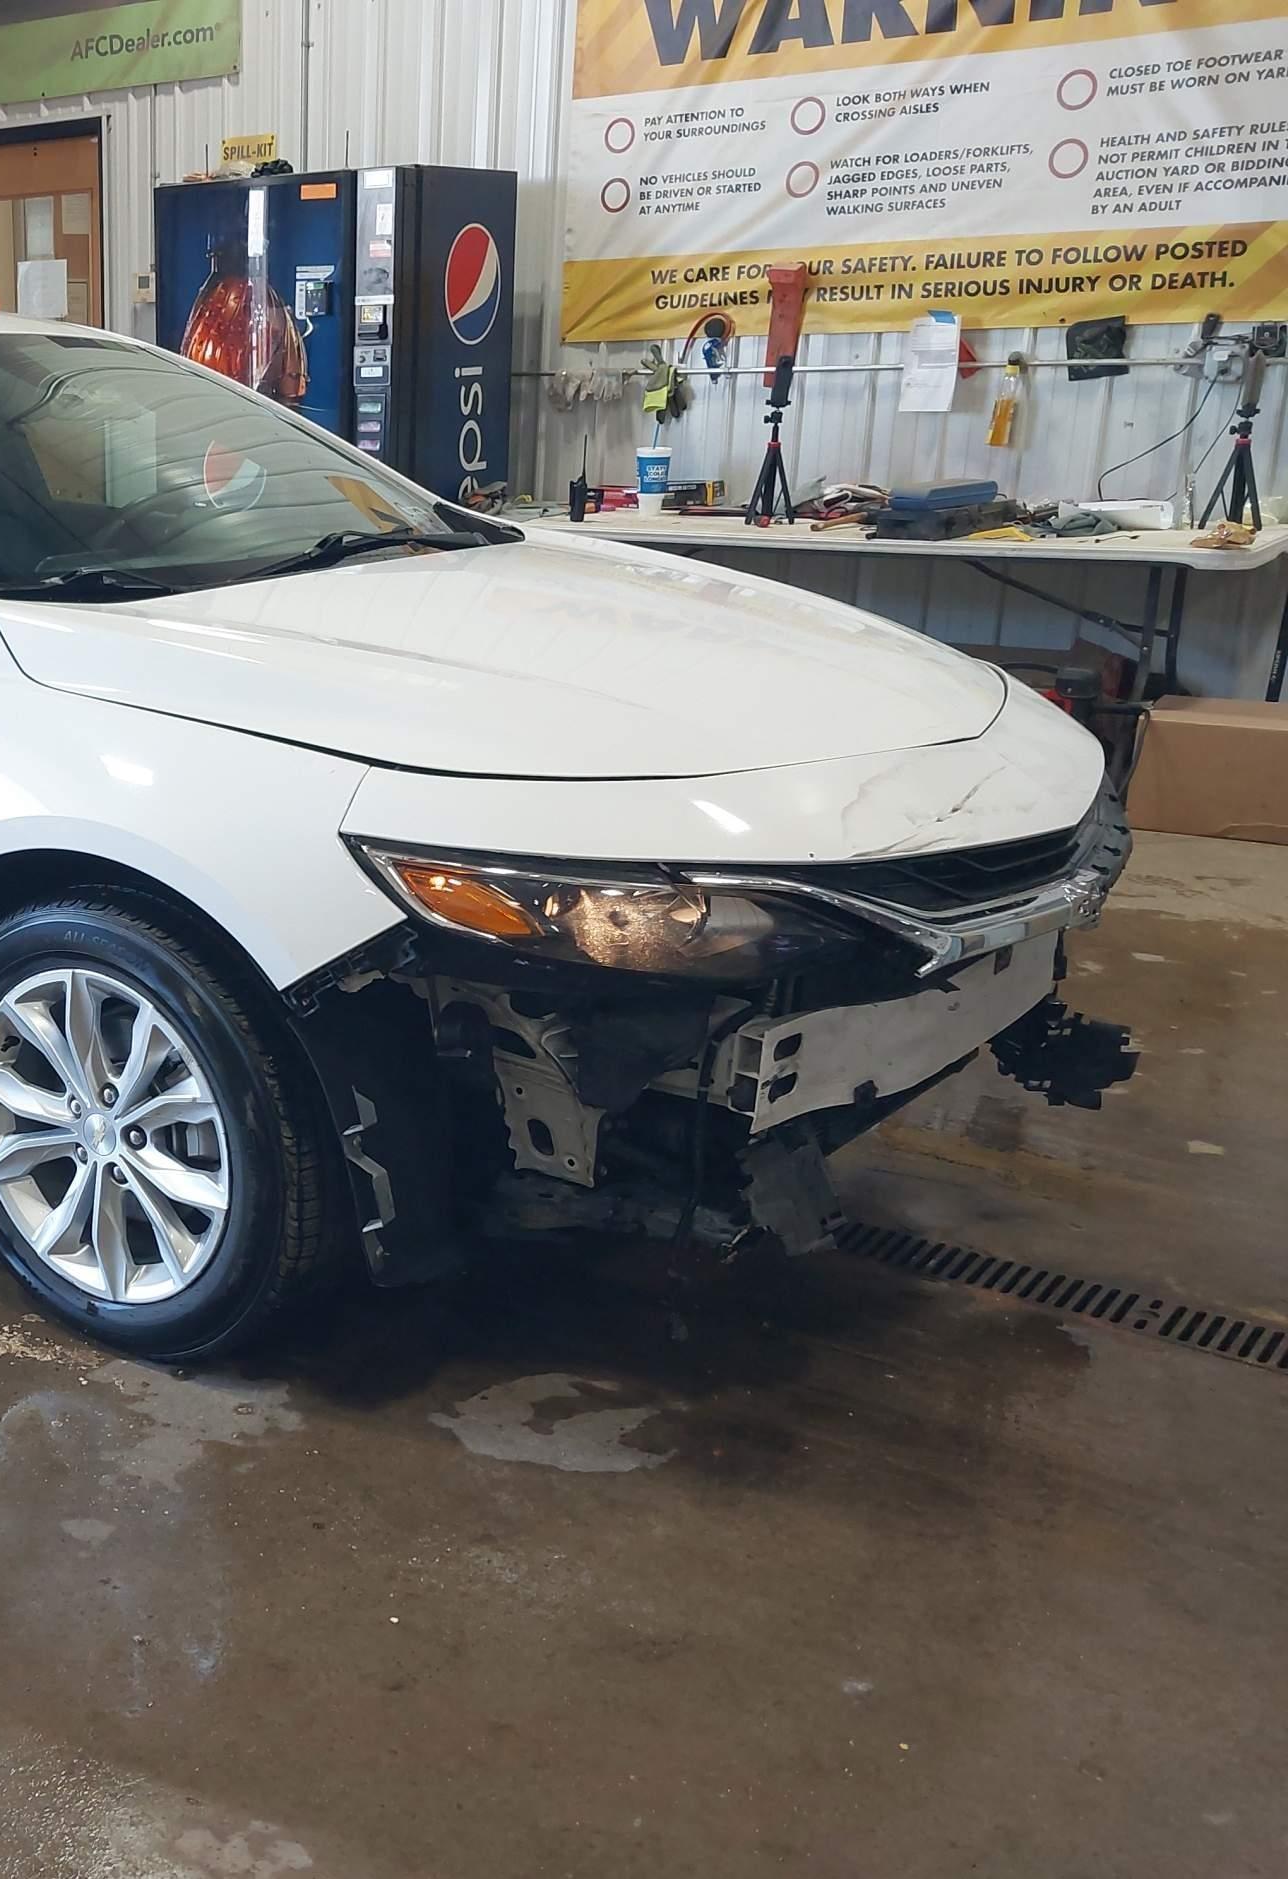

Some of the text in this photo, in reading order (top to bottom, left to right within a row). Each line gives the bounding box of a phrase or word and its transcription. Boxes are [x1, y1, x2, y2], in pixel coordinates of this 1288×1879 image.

[70, 25, 215, 62] AFCDealer.com
[1108, 49, 1284, 80] CLOSED TOE FOOTWEAR
[1106, 67, 1288, 96] MUST BE WORN ON YAR
[836, 82, 990, 107] LOOK BOTH WAYS WHEN
[644, 108, 744, 127] PAY ATTENTION TO
[835, 102, 940, 123] CROSSING AISLES
[644, 120, 766, 142] YOUR SURROUNDINGS
[1100, 120, 1288, 148] HEALTH AND SAFETY RULE
[224, 142, 274, 160] SPILL-KIT
[830, 144, 1034, 170] WATCH FOR LOADERS/FORKLIFTS,
[1098, 153, 1128, 165] NOT
[1131, 149, 1180, 162] PERMIT
[1184, 142, 1257, 158] CHILDREN
[1262, 140, 1280, 152] IN
[640, 168, 756, 186] NO VEHICLES SHOULD
[827, 161, 1010, 186] JAGGED EDGES, LOOSE PARTS,
[1095, 168, 1158, 182] AUCTION
[1162, 164, 1200, 178] YARD
[1204, 162, 1226, 174] OR
[640, 182, 762, 200] BE DRIVEN OR STARTED
[826, 178, 1003, 201] SHARP POINTS AND UNEVEN
[1092, 174, 1288, 199] AREA, EVEN IF ACCOMPANI
[638, 202, 700, 216] AT ANYTIME
[826, 198, 946, 216] WALKING SURFACES
[1091, 200, 1182, 215] BY AN ADULT
[651, 268, 678, 285] WE
[684, 265, 730, 283] CARE
[796, 260, 834, 276] UR
[841, 255, 916, 275] SAFETY.
[924, 250, 1007, 271] FAILURE
[1014, 248, 1044, 267] TO
[1052, 244, 1148, 265] FOLLOW
[1155, 240, 1248, 261] POSTED
[655, 290, 760, 310] GUIDELINES
[816, 284, 885, 302] RESULT
[890, 282, 914, 300] IN
[920, 279, 1010, 299] SERIOUS
[1018, 275, 1101, 294] INJURY
[1108, 273, 1142, 292] OR
[1151, 270, 1234, 290] DEATH.
